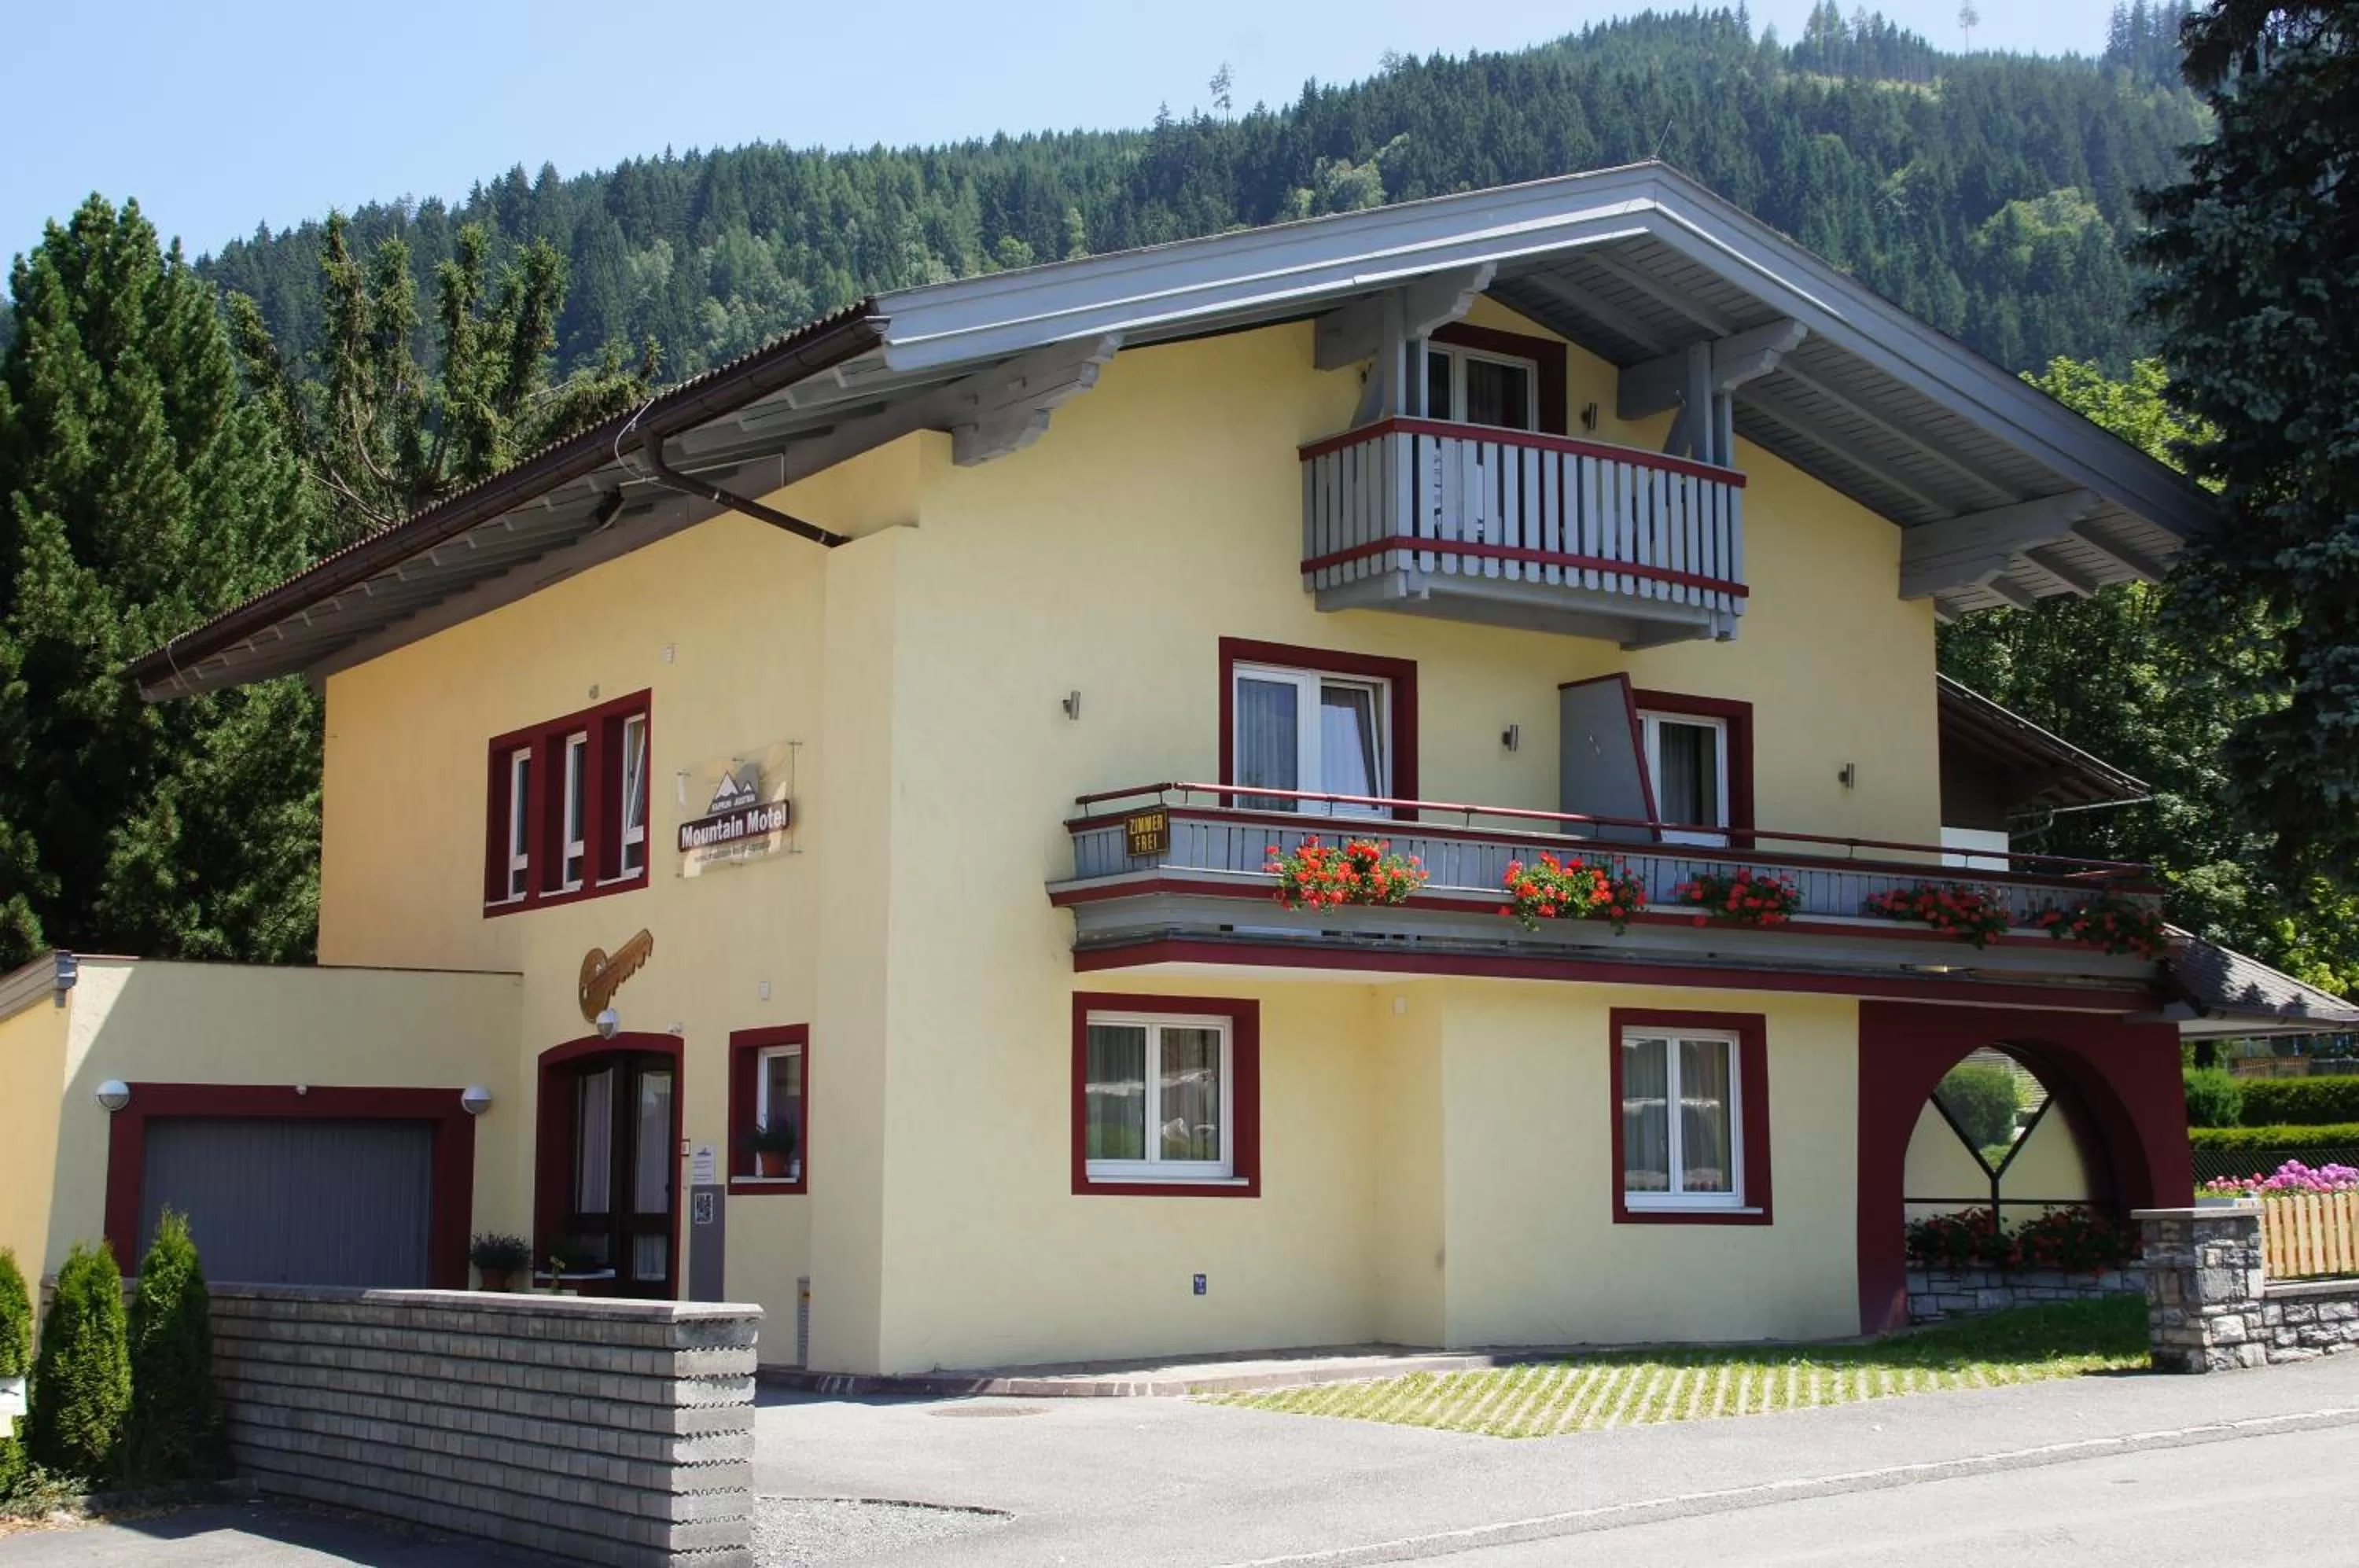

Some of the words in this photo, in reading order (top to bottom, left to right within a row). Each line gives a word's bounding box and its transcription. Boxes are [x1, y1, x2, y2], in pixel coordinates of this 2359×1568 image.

[682, 815, 743, 848] Mountain
[747, 804, 787, 834] Motel
[1129, 814, 1163, 834] ZIMMER
[1135, 833, 1157, 852] FREI
